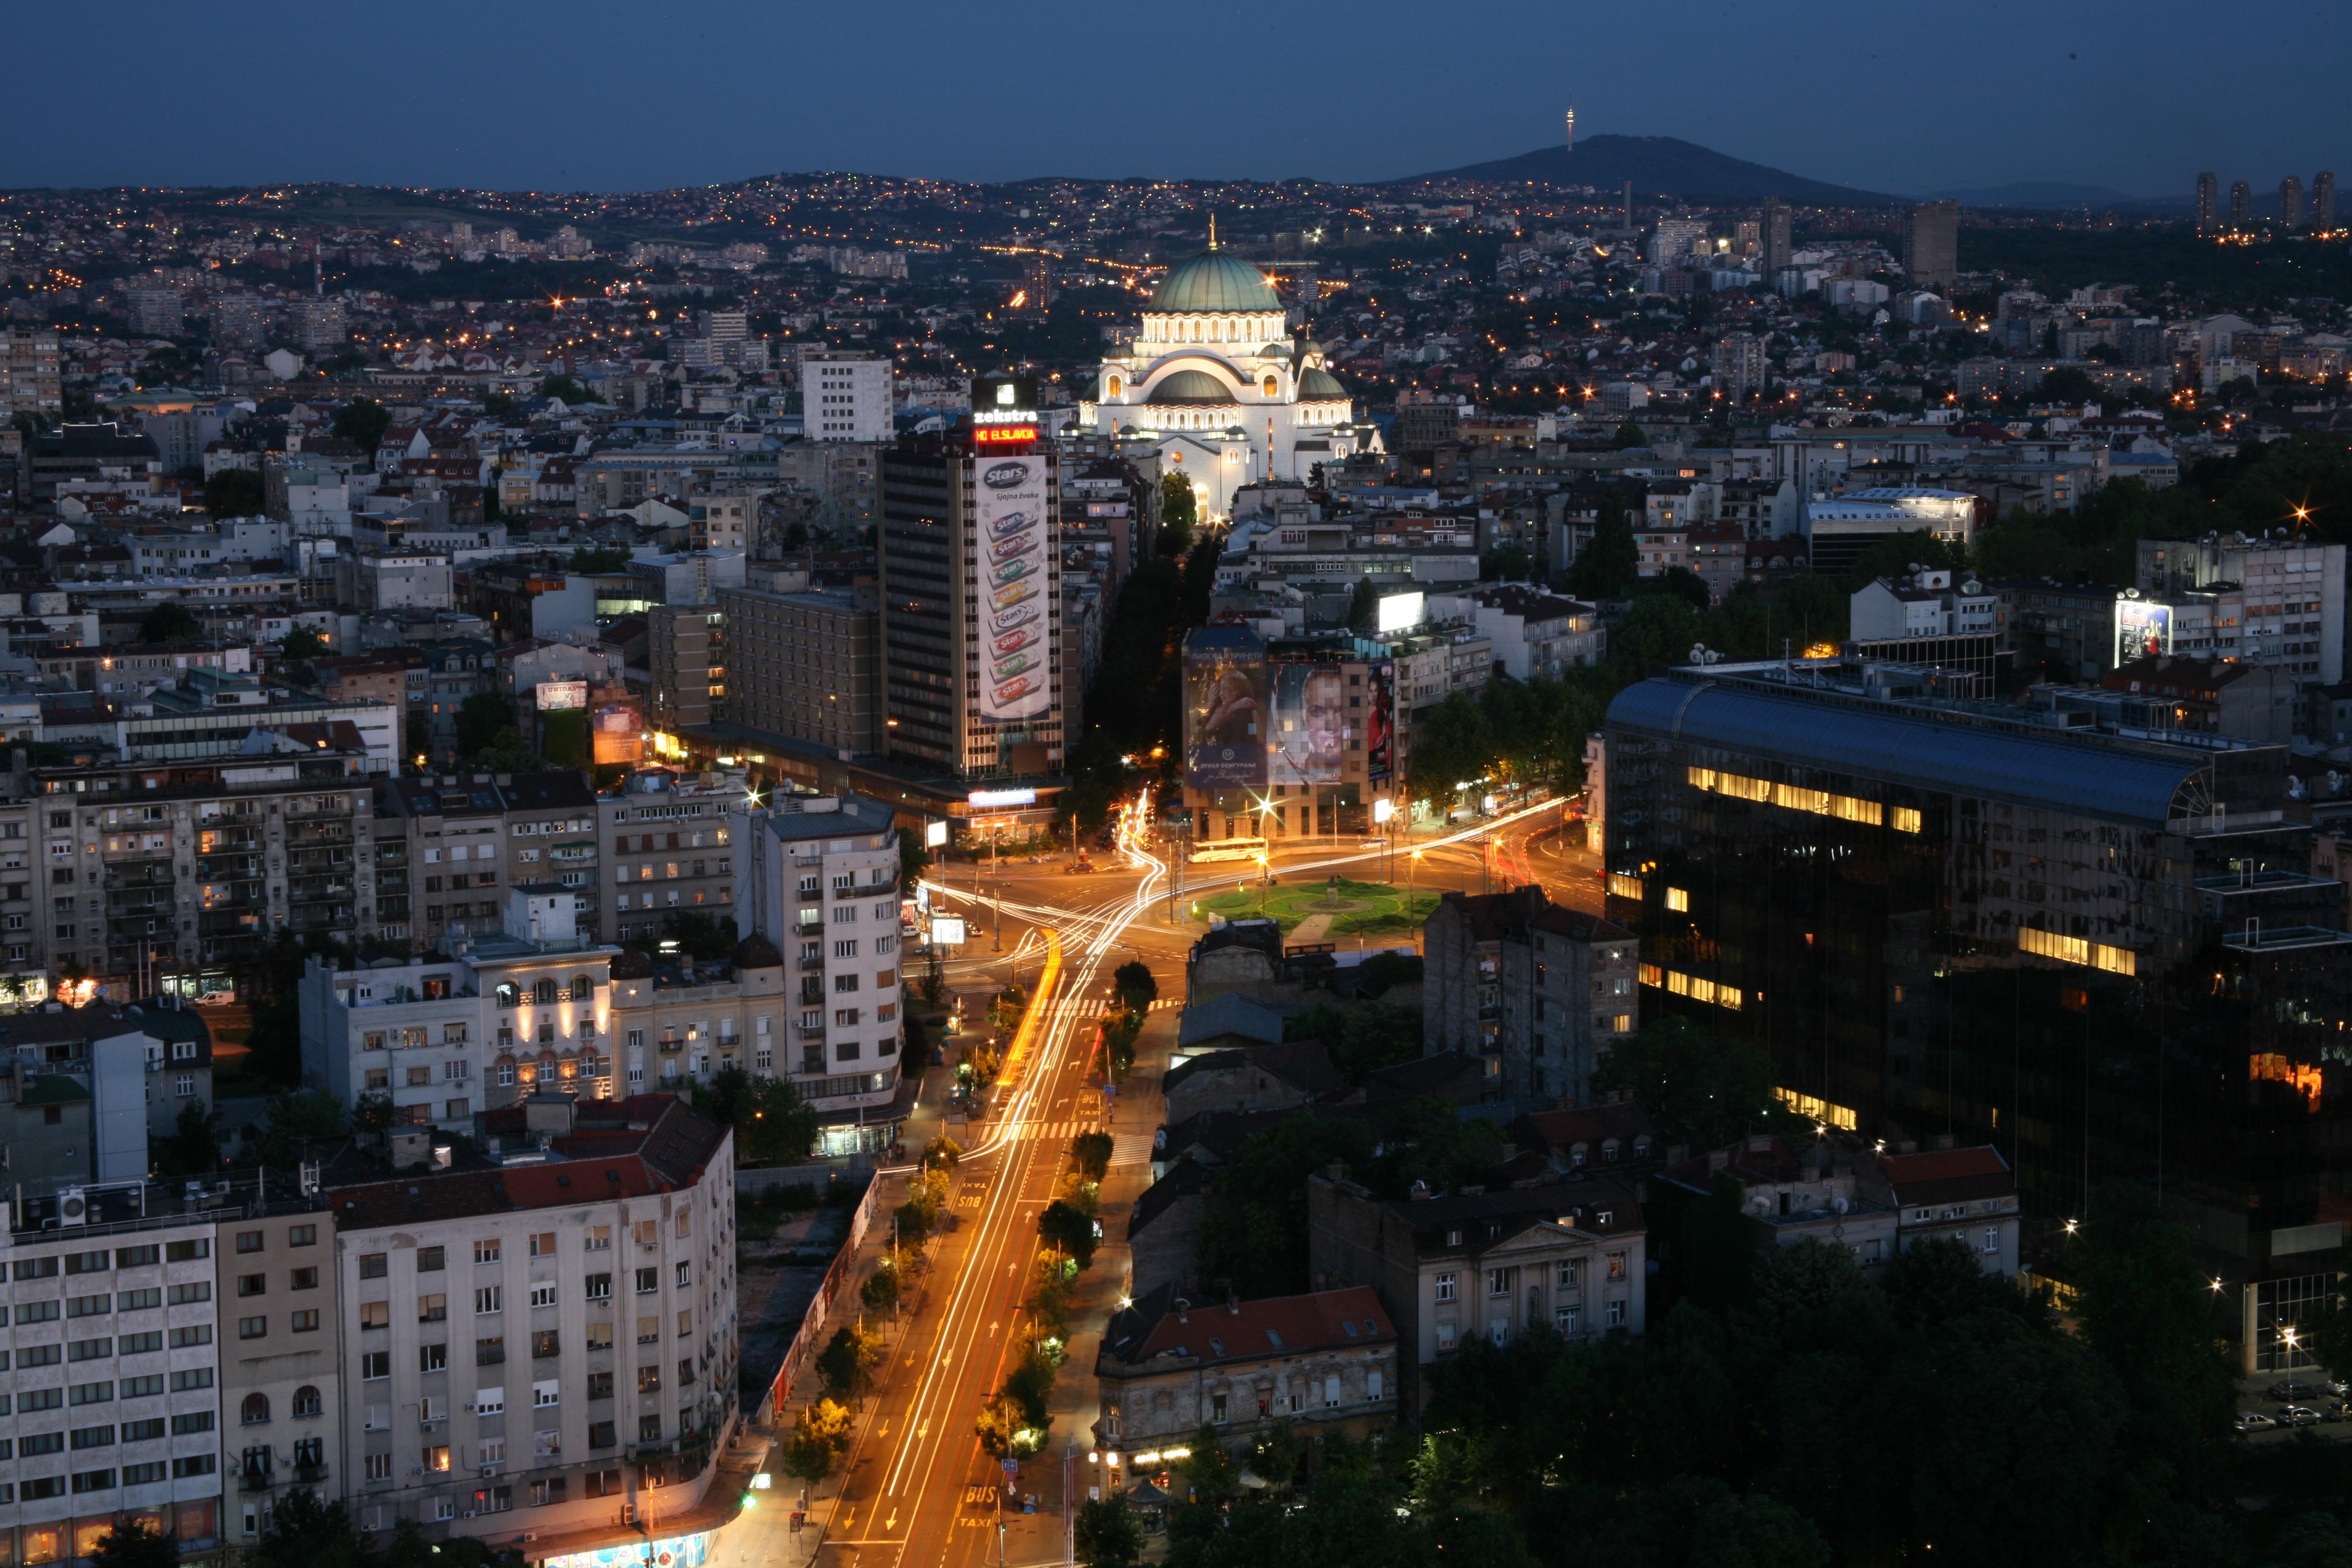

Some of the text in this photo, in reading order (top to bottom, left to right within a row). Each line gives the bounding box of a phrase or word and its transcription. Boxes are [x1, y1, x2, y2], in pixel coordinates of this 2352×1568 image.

[974, 409, 1038, 423] zekstra
[987, 467, 1023, 484] Stars
[996, 493, 1017, 501] Sjajna
[997, 514, 1021, 530] Stars
[998, 537, 1021, 554] Stars
[999, 561, 1022, 578] Stars
[1000, 585, 1023, 600] Stars
[1000, 608, 1022, 624] Stars
[1000, 632, 1023, 648] Stars
[1000, 655, 1024, 672] Stars
[1002, 680, 1024, 696] Stars
[958, 1196, 982, 1208] BUS
[965, 1486, 997, 1503] BUS
[960, 1518, 991, 1528] TAXI
